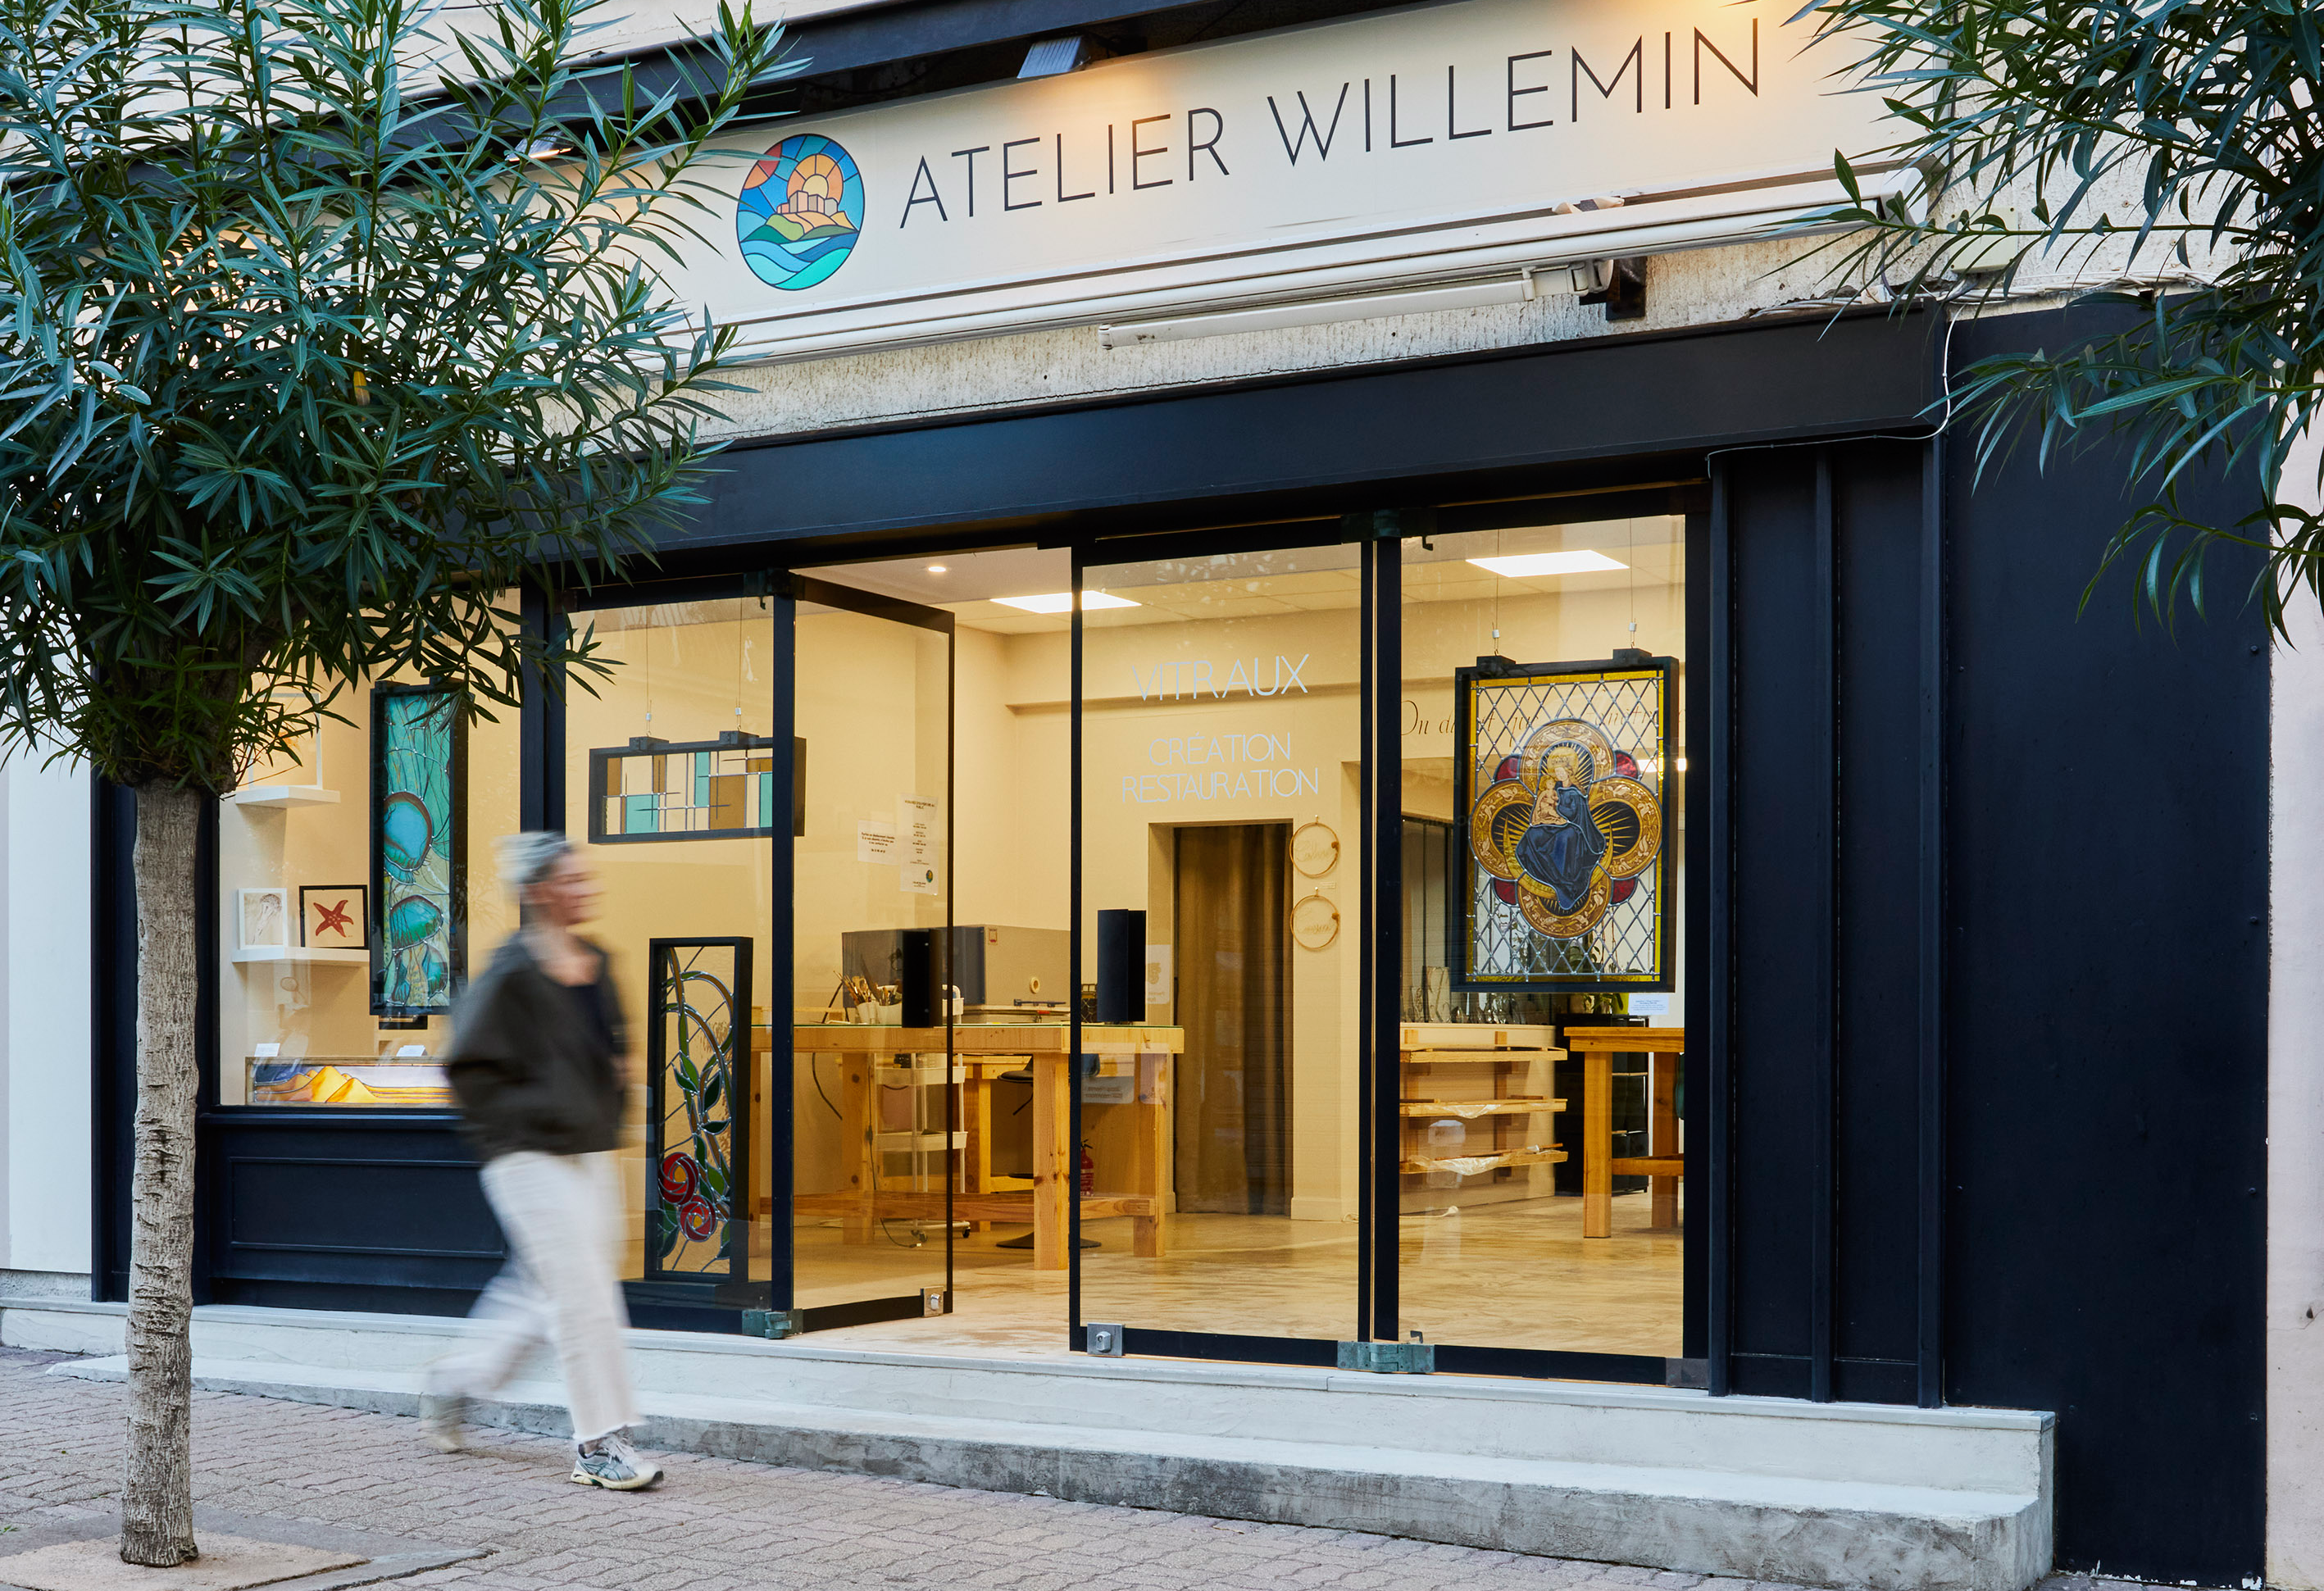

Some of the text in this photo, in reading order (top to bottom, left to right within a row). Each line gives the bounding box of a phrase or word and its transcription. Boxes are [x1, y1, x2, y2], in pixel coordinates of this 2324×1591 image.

[900, 19, 1758, 229] ATELIER WILLEMIN
[1131, 653, 1309, 701] VITRAUX
[1148, 732, 1290, 766] CRÉATION
[1122, 768, 1319, 803] RESTAURATION
